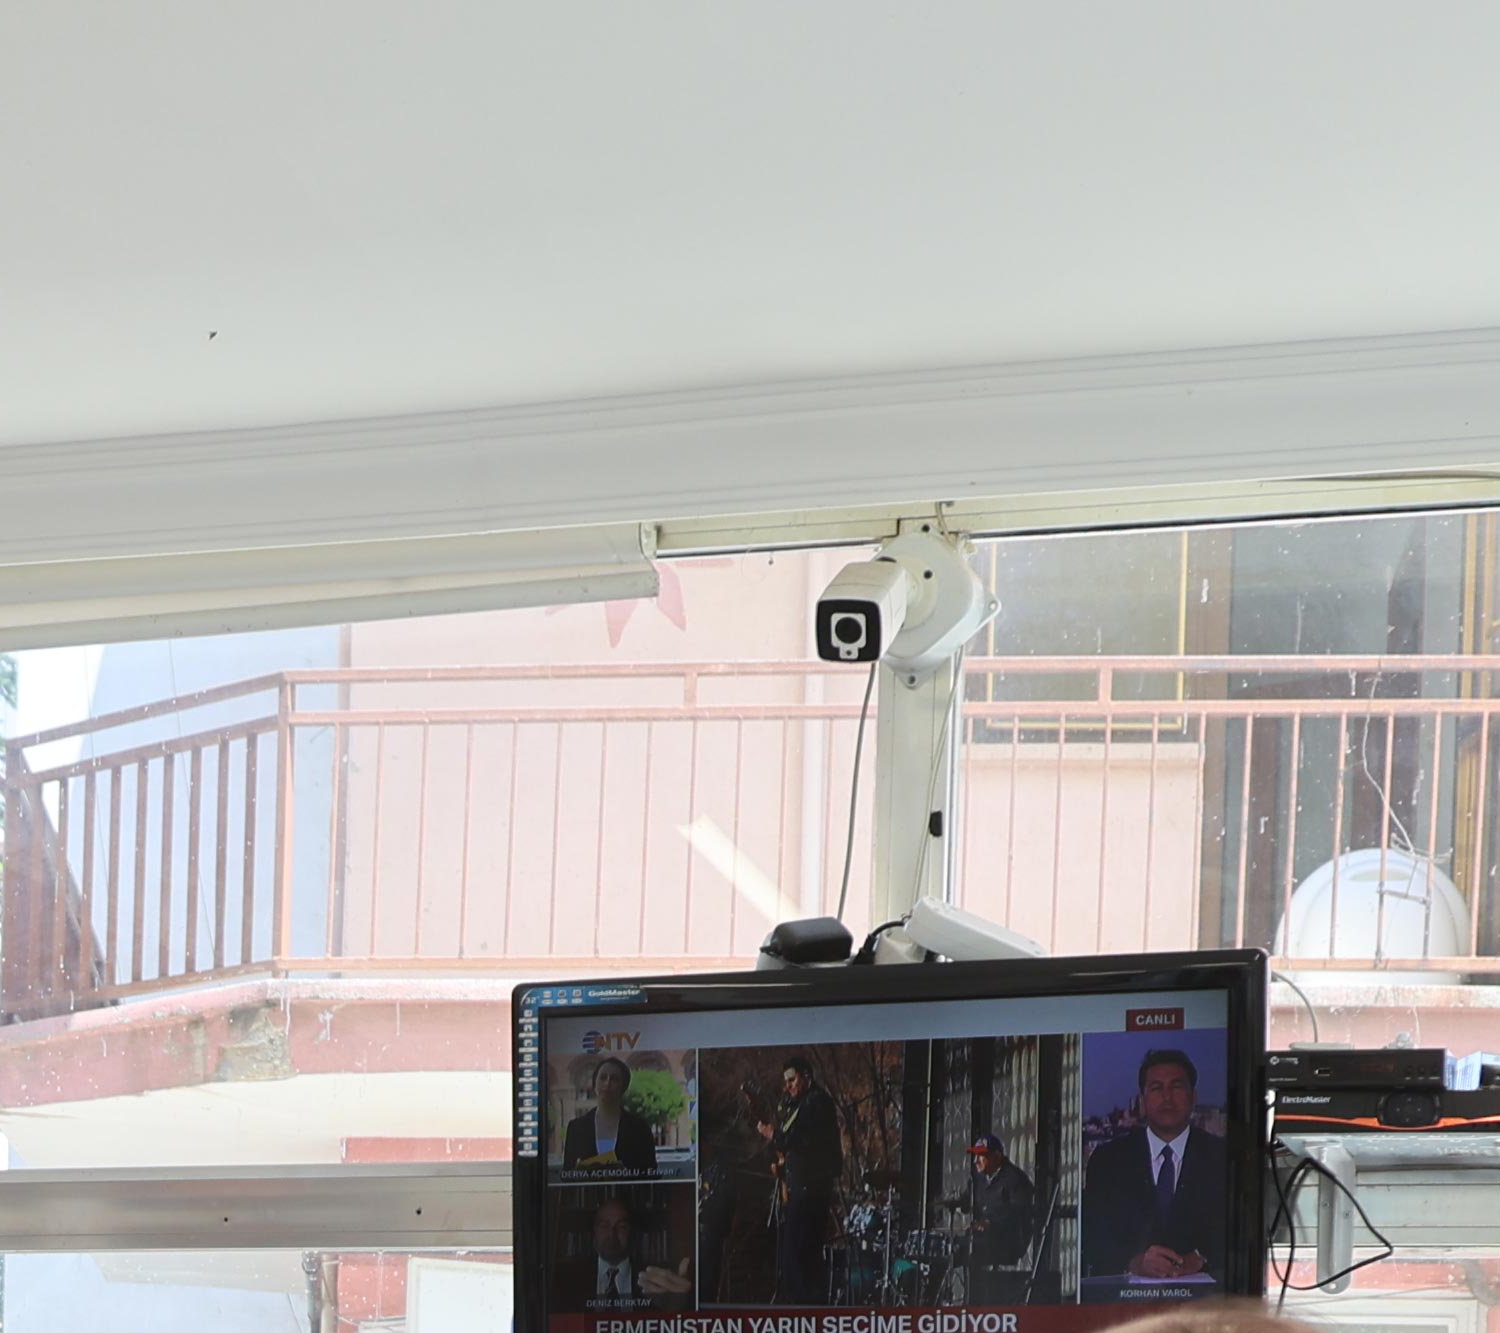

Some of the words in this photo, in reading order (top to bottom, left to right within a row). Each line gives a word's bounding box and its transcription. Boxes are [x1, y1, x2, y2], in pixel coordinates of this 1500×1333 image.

[1135, 1013, 1177, 1028] CANLI
[595, 1031, 641, 1051] NTV
[1119, 1287, 1160, 1298] KORHAN
[1161, 1286, 1194, 1297] VAROL
